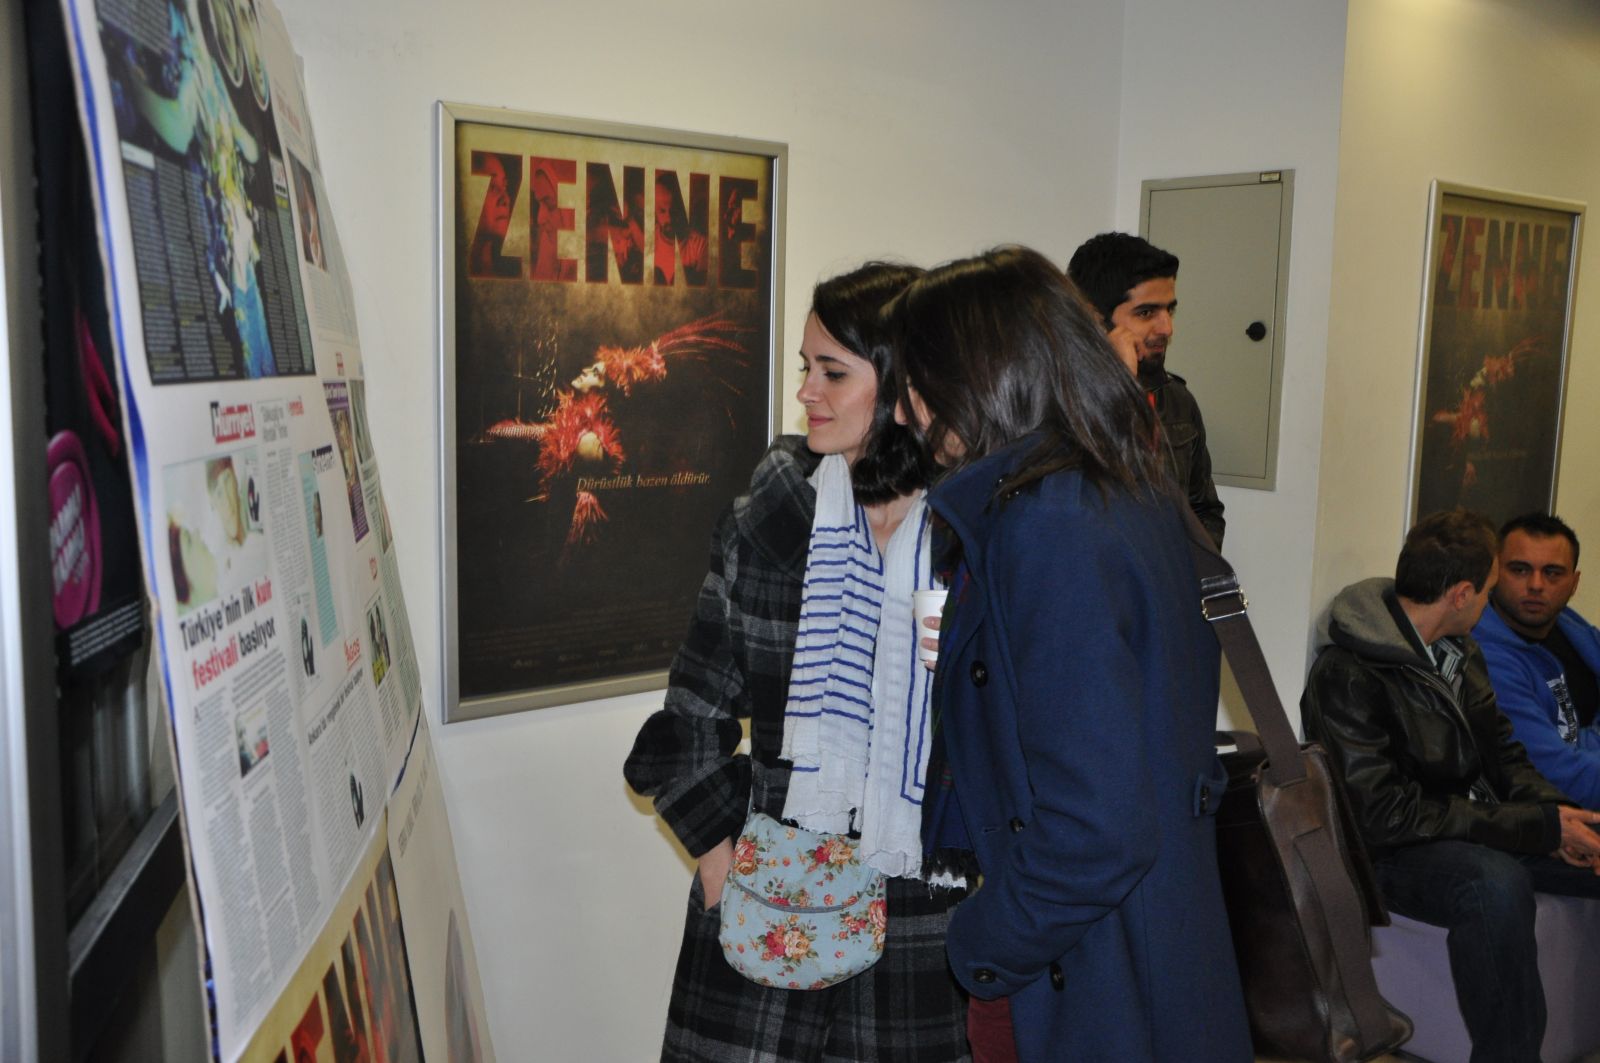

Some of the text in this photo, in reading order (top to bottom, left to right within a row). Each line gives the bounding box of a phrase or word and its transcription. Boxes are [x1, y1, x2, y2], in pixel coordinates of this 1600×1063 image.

[470, 149, 759, 288] ZENNE
[1435, 213, 1568, 314] ZENNE
[577, 474, 632, 491] Dürüstlük
[636, 474, 668, 488] bazen
[180, 593, 242, 652] Türkiye'nin
[242, 585, 256, 615] ilk
[193, 632, 240, 691] festivali
[239, 616, 277, 658] başlıyor
